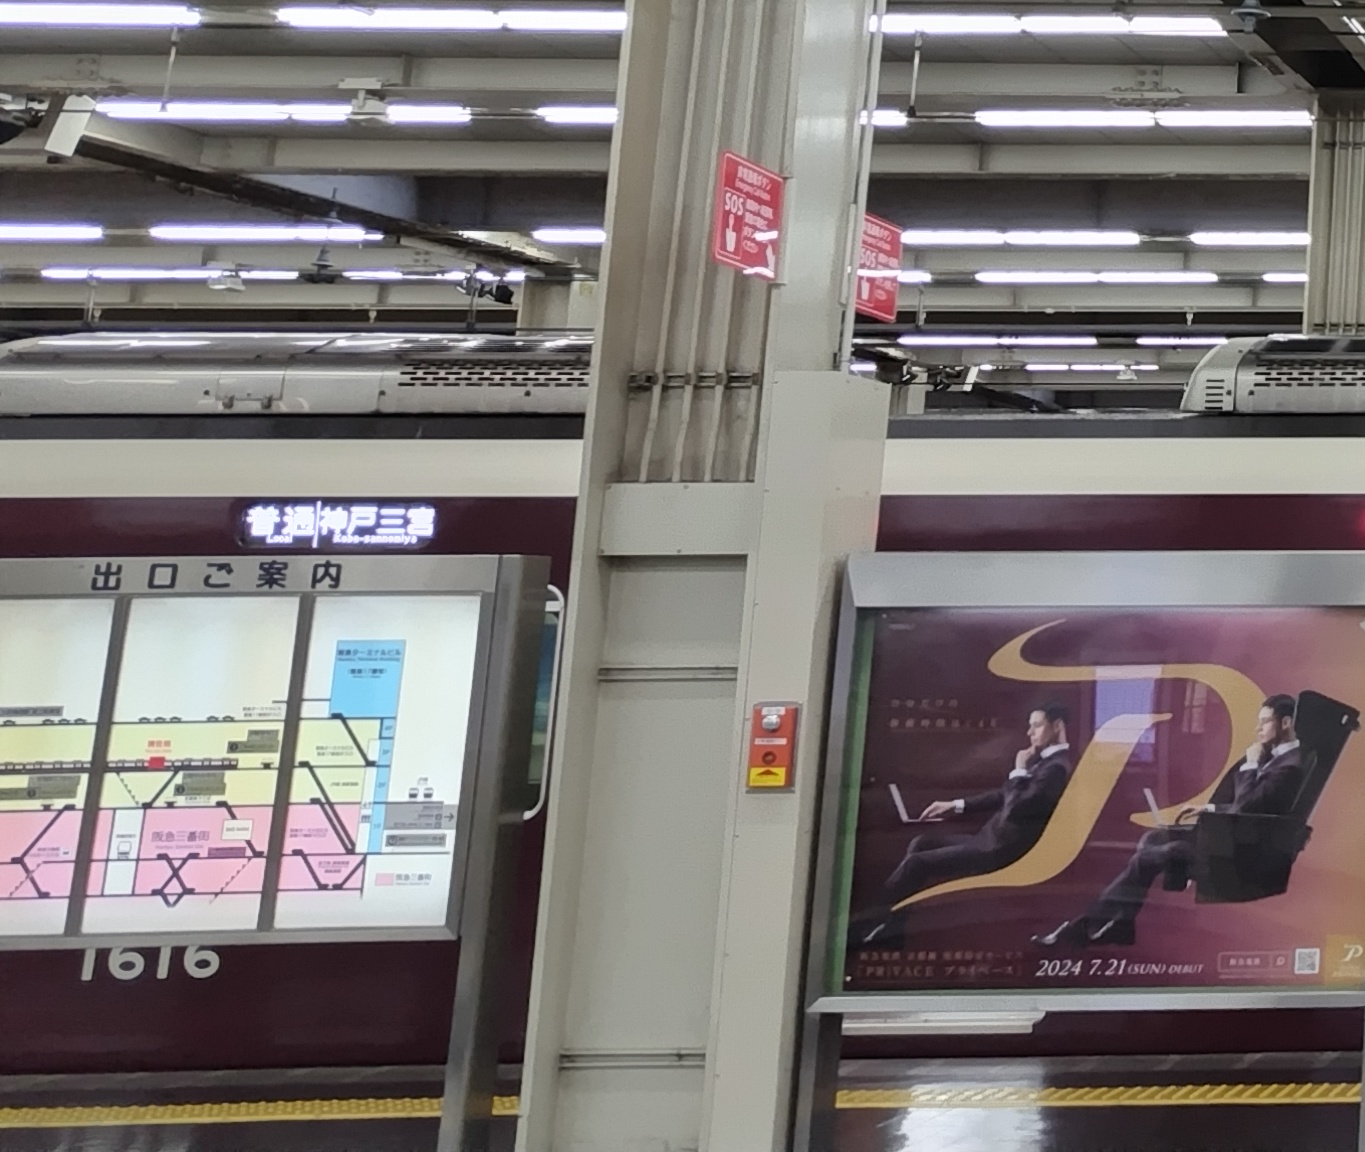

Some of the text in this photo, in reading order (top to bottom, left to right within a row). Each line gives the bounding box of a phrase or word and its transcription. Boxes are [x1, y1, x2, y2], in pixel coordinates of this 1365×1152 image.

[724, 192, 744, 216] SOS
[246, 505, 315, 537] 普通
[318, 505, 436, 537] 神戸三宮
[332, 533, 418, 545] Kobe-sannomiya
[91, 560, 342, 591] 出口ご案内
[80, 945, 220, 981] 1616
[1035, 959, 1204, 977] 2024 7.21 (SUN) DEBUT
